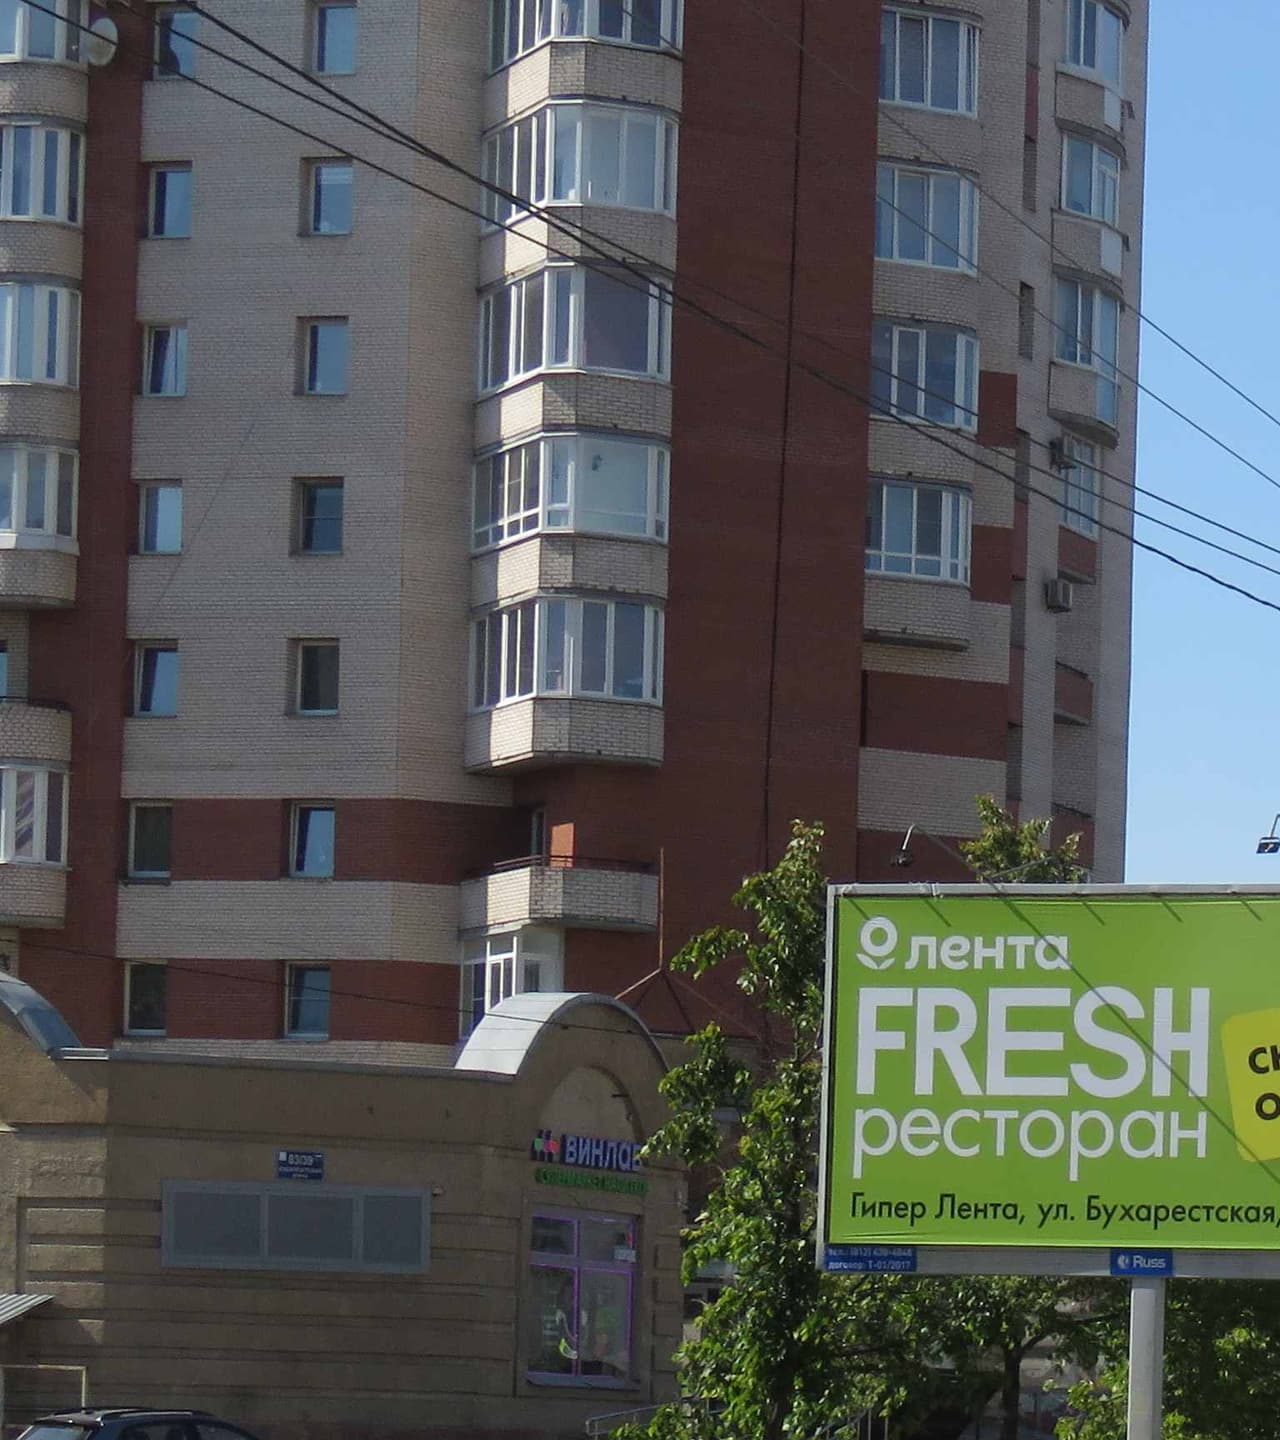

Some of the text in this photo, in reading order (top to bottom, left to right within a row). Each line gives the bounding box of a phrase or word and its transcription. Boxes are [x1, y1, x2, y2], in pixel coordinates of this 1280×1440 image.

[905, 934, 1071, 970] лента
[856, 987, 1210, 1097] FRESH
[852, 1106, 1207, 1182] ресторан
[851, 1192, 926, 1226] Гипер
[936, 1193, 1026, 1226] Лента,
[1037, 1203, 1076, 1227] ул.
[1132, 1255, 1166, 1268] Russ
